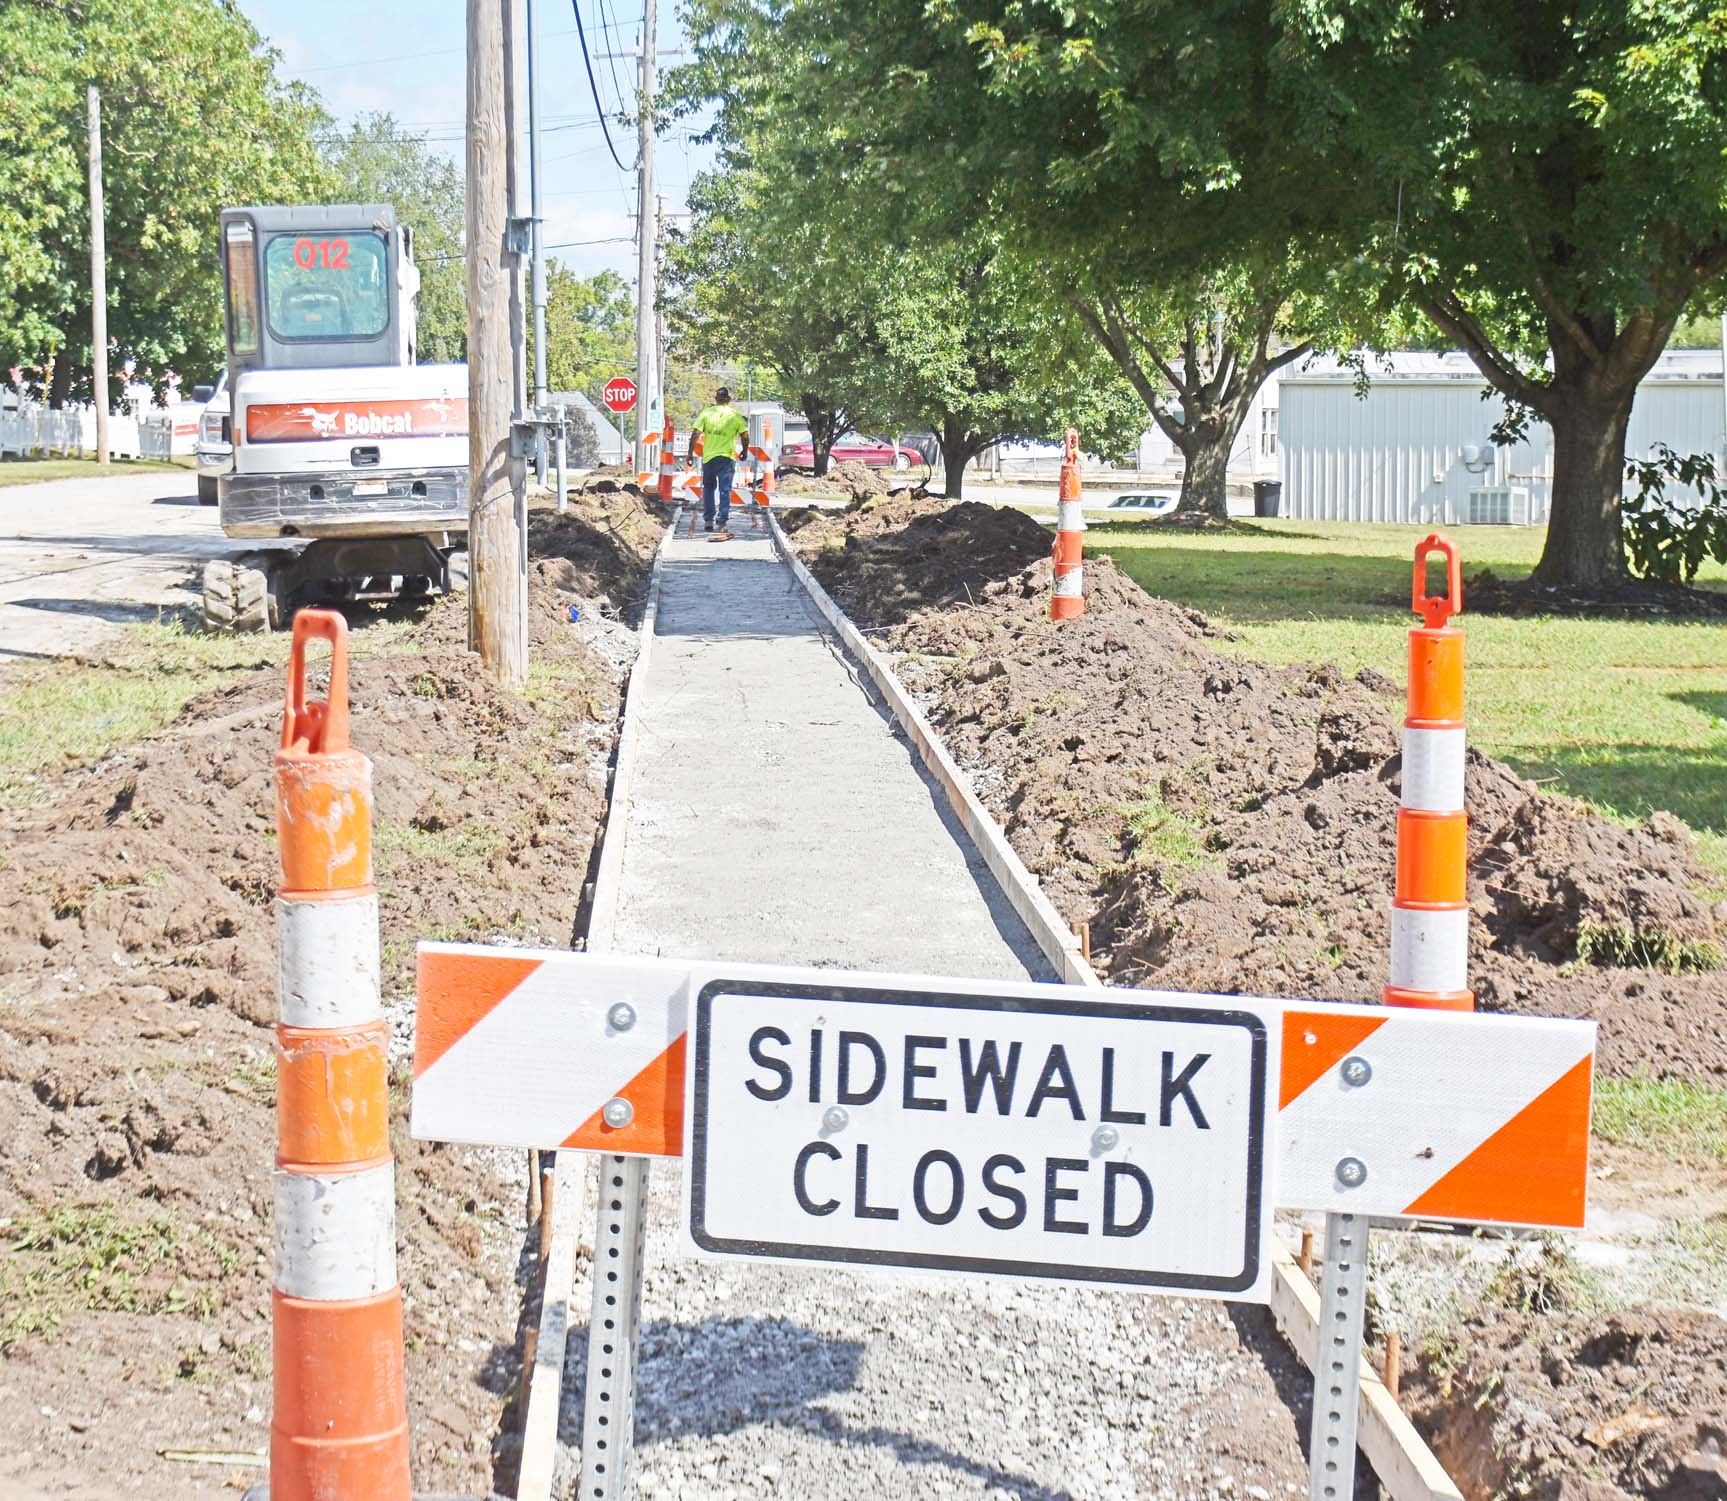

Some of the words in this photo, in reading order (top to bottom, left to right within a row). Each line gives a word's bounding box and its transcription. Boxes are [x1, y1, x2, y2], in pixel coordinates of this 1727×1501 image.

[294, 239, 350, 269] 012
[606, 388, 635, 401] STOP
[344, 411, 412, 434] Bobcat
[745, 1026, 1211, 1129] SIDEWALK
[793, 1141, 1154, 1238] CLOSED
